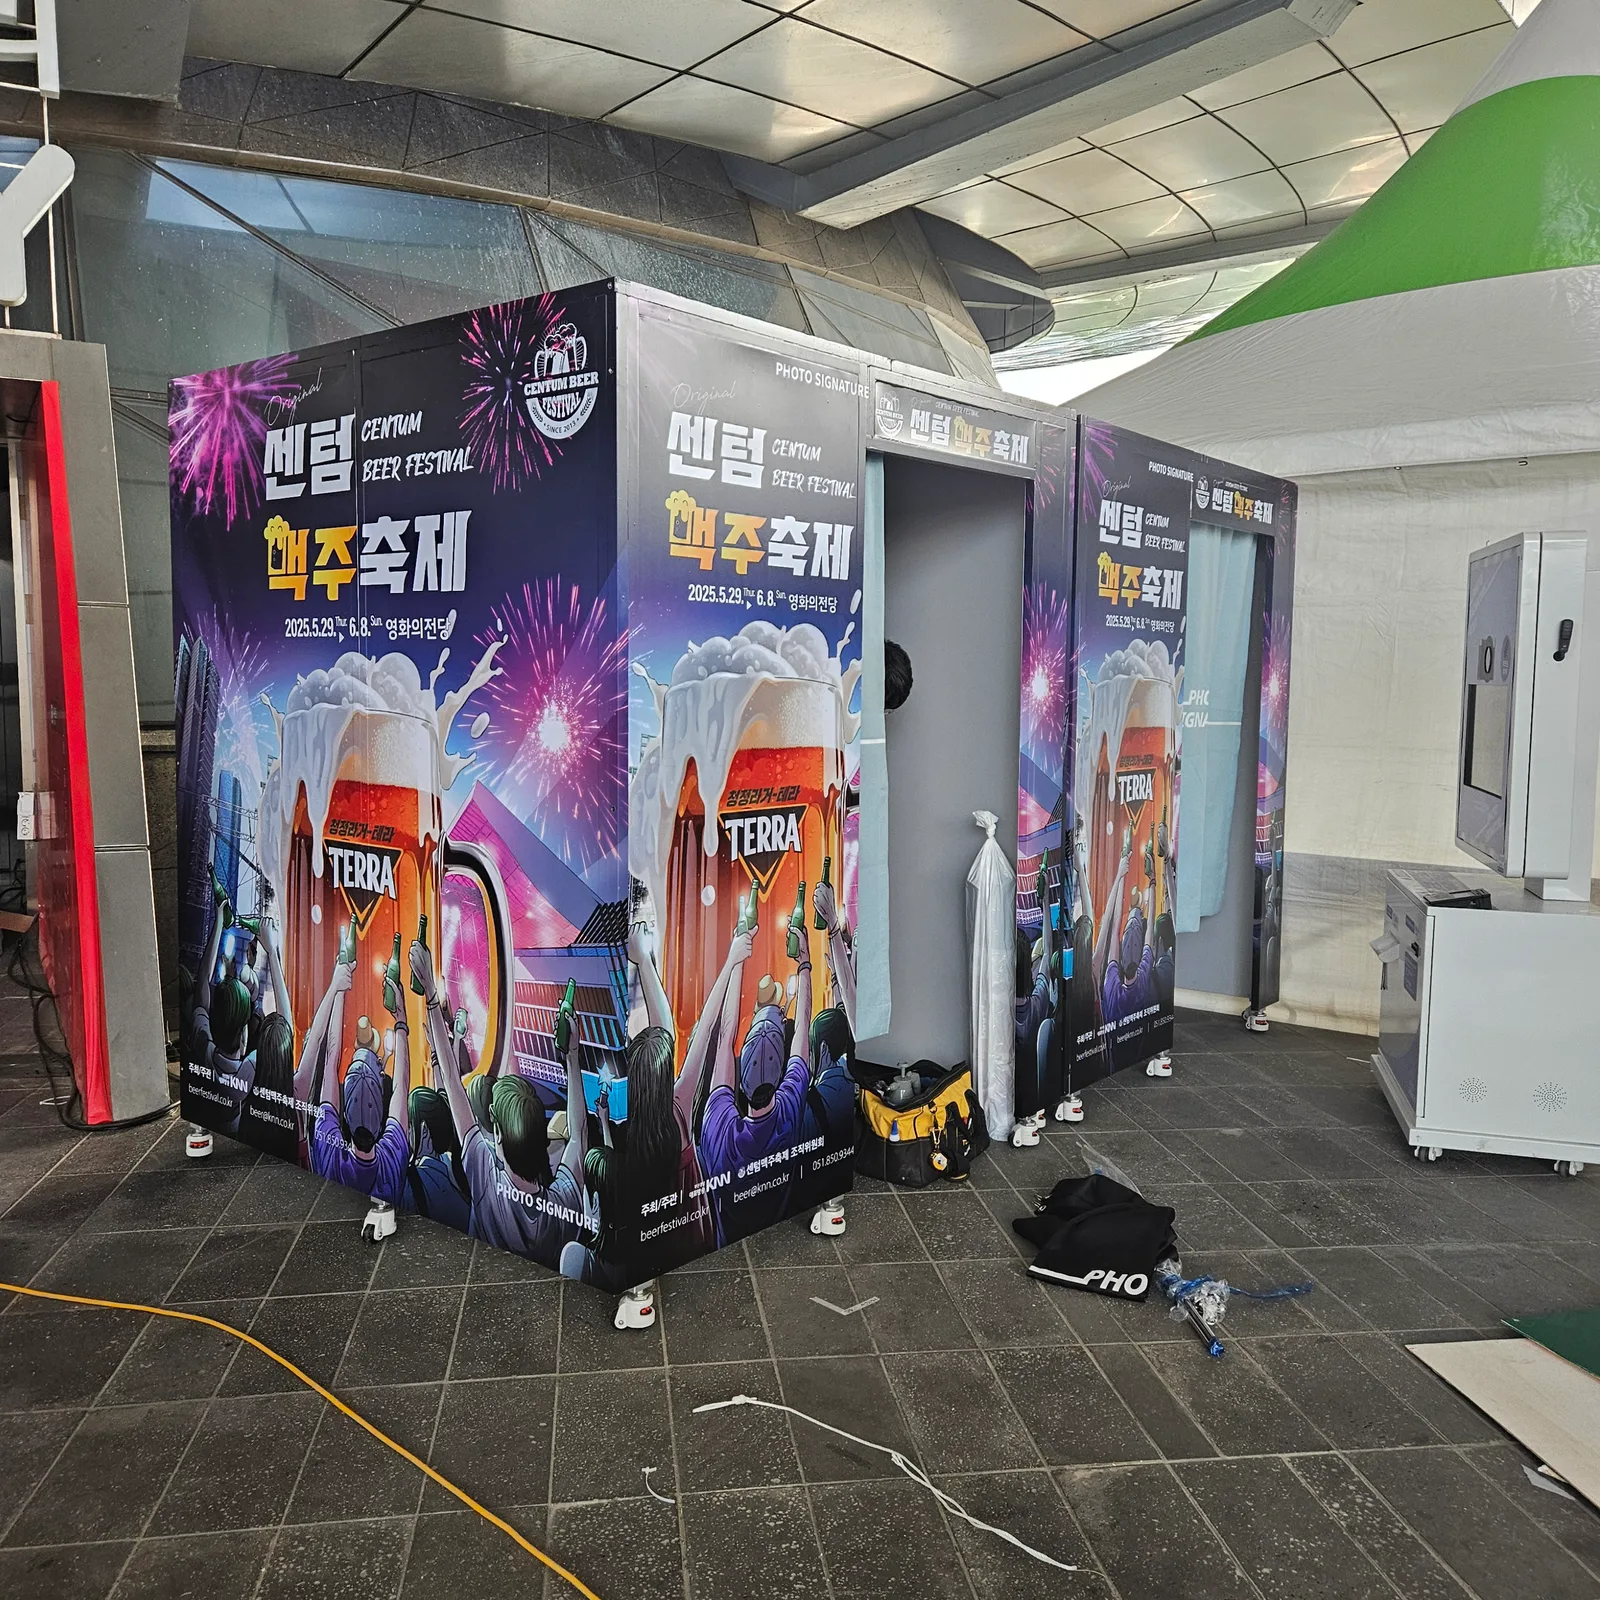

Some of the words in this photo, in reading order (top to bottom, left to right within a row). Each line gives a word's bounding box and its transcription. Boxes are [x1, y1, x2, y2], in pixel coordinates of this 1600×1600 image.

[264, 367, 322, 426] Original
[524, 376, 568, 396] CENTUM
[569, 371, 600, 391] BEER
[776, 362, 813, 384] PHOTO
[815, 372, 870, 399] SIGNATURE
[541, 392, 581, 419] FESTIVAL
[670, 380, 737, 415] Original
[361, 410, 422, 442] CENTUM
[546, 425, 562, 434] SINCE
[563, 420, 577, 433] 2013
[263, 413, 356, 501] 센텀
[361, 454, 401, 483] BEER
[405, 446, 474, 477] FESTIVAL
[666, 411, 768, 489] 센텀
[771, 438, 822, 462] CENTUM
[771, 469, 804, 493] BEER
[807, 475, 857, 499] FESTIVAL
[1148, 461, 1167, 475] PHOTO
[1167, 466, 1194, 482] SIGNATURE
[1098, 499, 1145, 549] 센텀
[1145, 513, 1170, 528] CENTUM
[1144, 534, 1161, 550] BEER
[1161, 537, 1186, 553] FESTIVAL
[788, 594, 838, 614] 영화의전당
[385, 617, 451, 641] 영화의전당
[1118, 773, 1153, 805] TERRA
[724, 812, 802, 862] TERRA
[328, 846, 397, 900] TERRA
[230, 1074, 248, 1093] KNN
[188, 1082, 233, 1108] beerfestival.co.kr
[249, 1105, 295, 1131] beer@knn.co.kr
[640, 1191, 678, 1217] 주최/주관
[705, 1170, 731, 1193] KNN
[746, 1148, 790, 1176] 센텀맥주축제
[790, 1135, 825, 1159] 조직위원회
[496, 1182, 534, 1207] PHOTO
[536, 1197, 600, 1235] SIGNATURE
[640, 1205, 710, 1242] beerfestival.co.kr
[733, 1172, 790, 1204] beer@knn.co.kr
[812, 1145, 855, 1171] 051.850.9344
[1084, 1269, 1149, 1296] PHO
